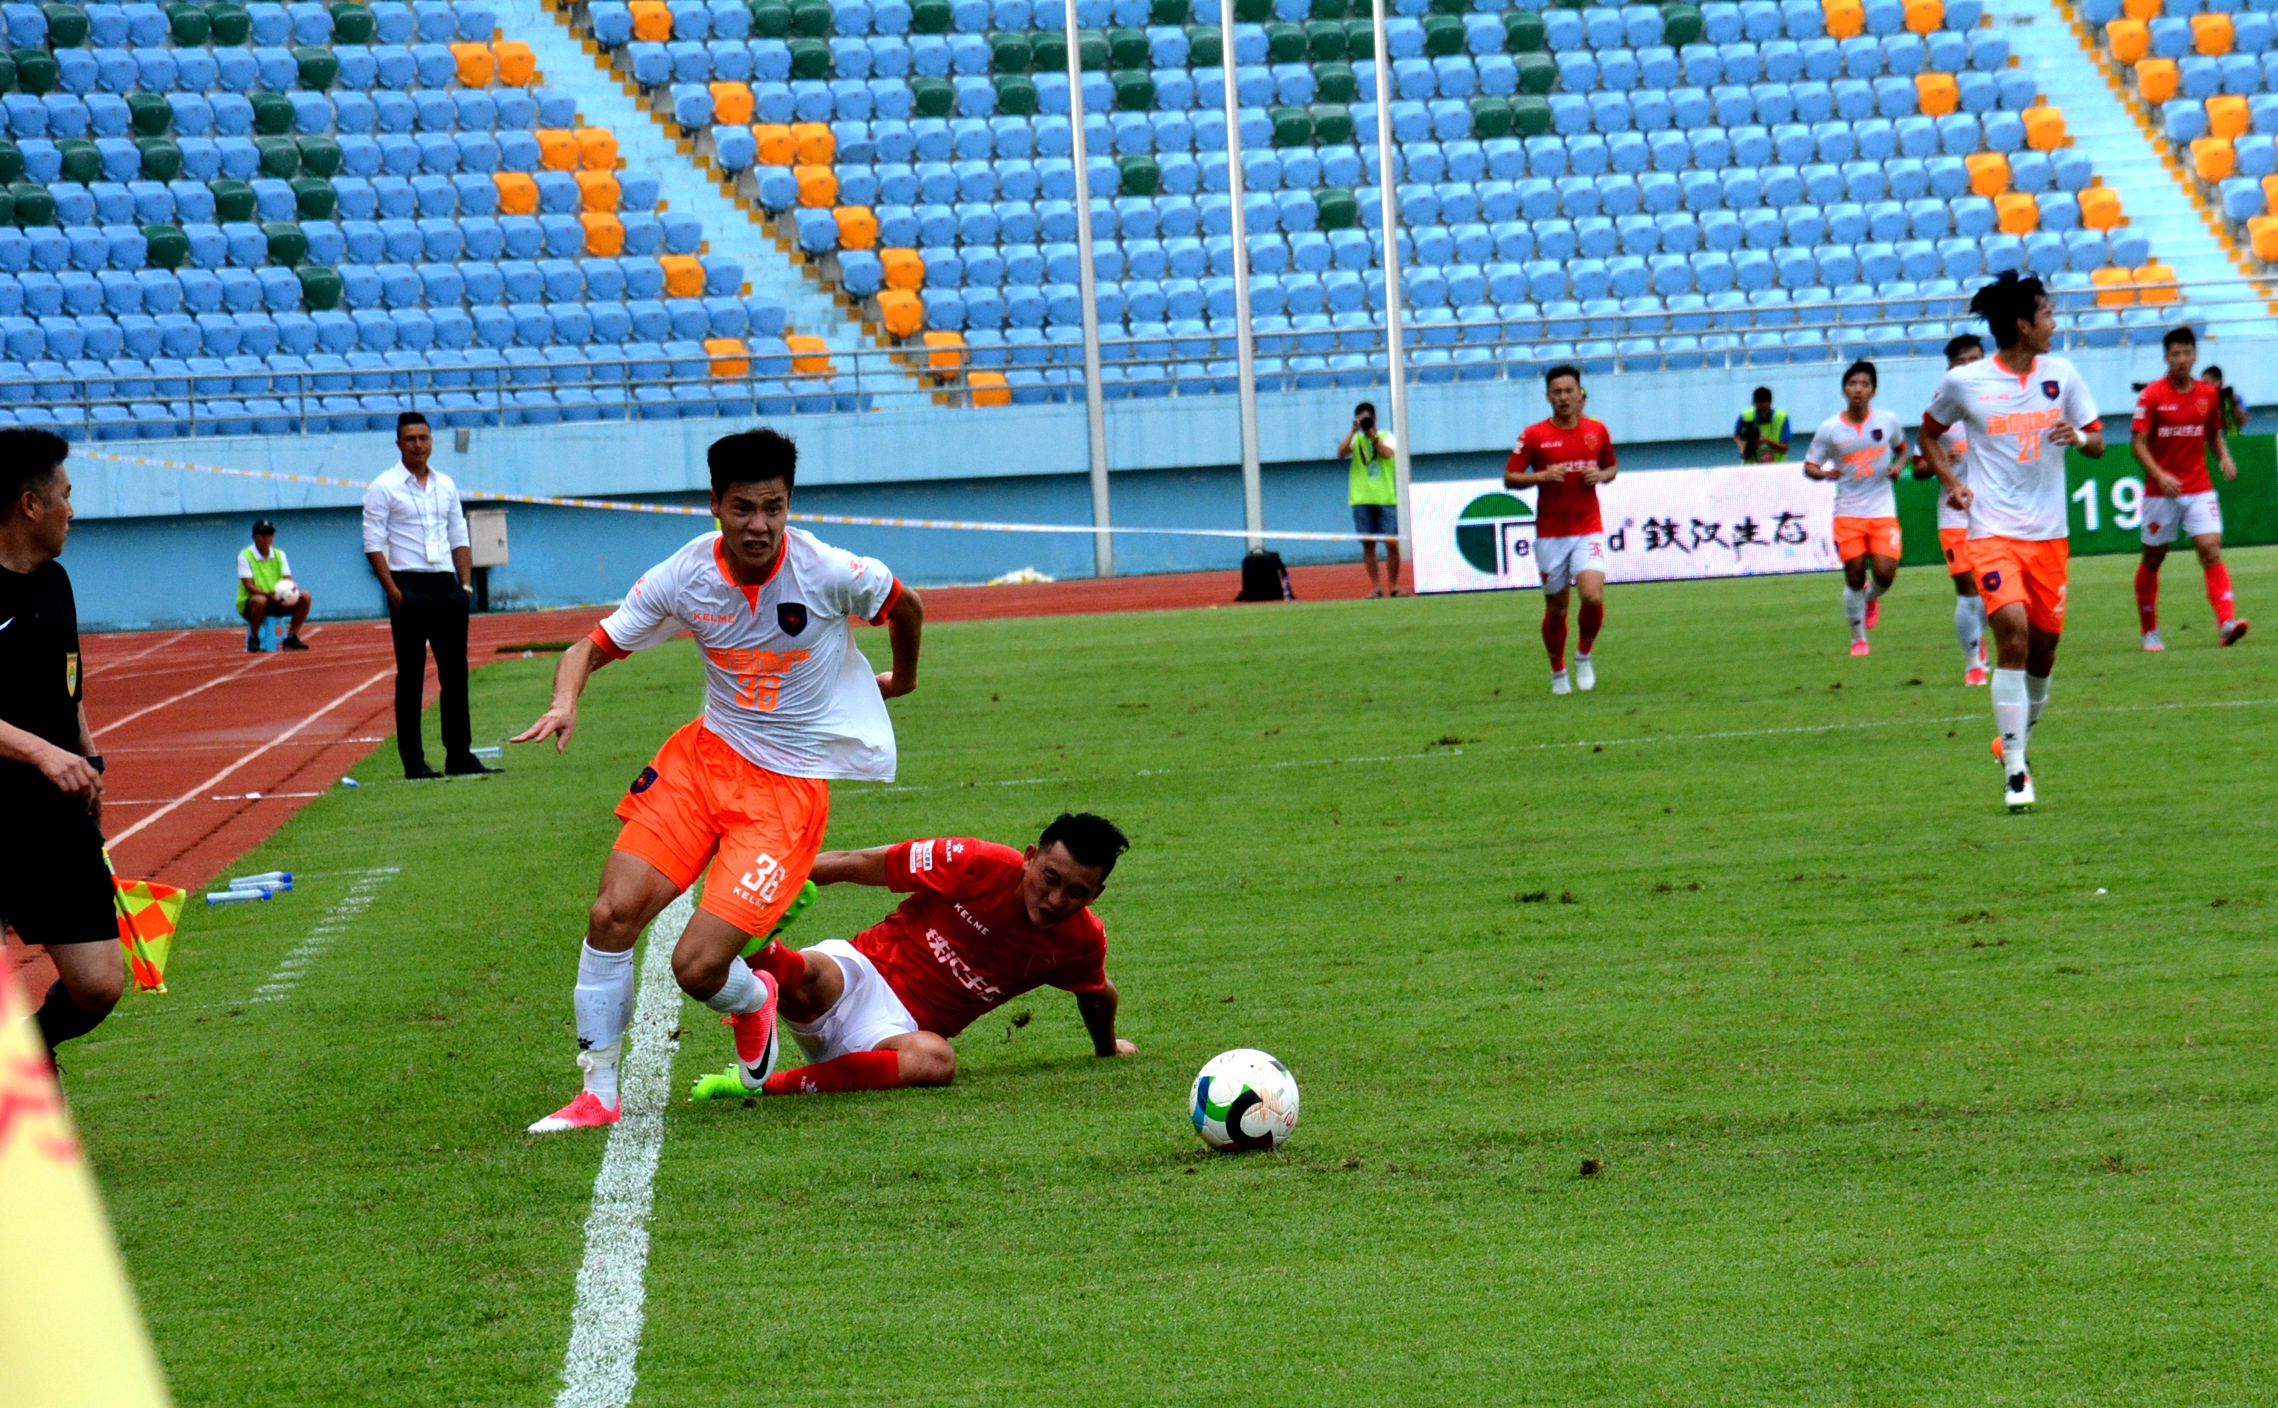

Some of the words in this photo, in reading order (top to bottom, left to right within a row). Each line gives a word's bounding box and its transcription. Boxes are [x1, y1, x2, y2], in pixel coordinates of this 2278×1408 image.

[2016, 432, 2041, 463] 21
[693, 612, 735, 623] KELME
[735, 674, 781, 712] 36
[740, 853, 787, 903] 36
[732, 886, 767, 911] KELME
[954, 902, 990, 936] KELME
